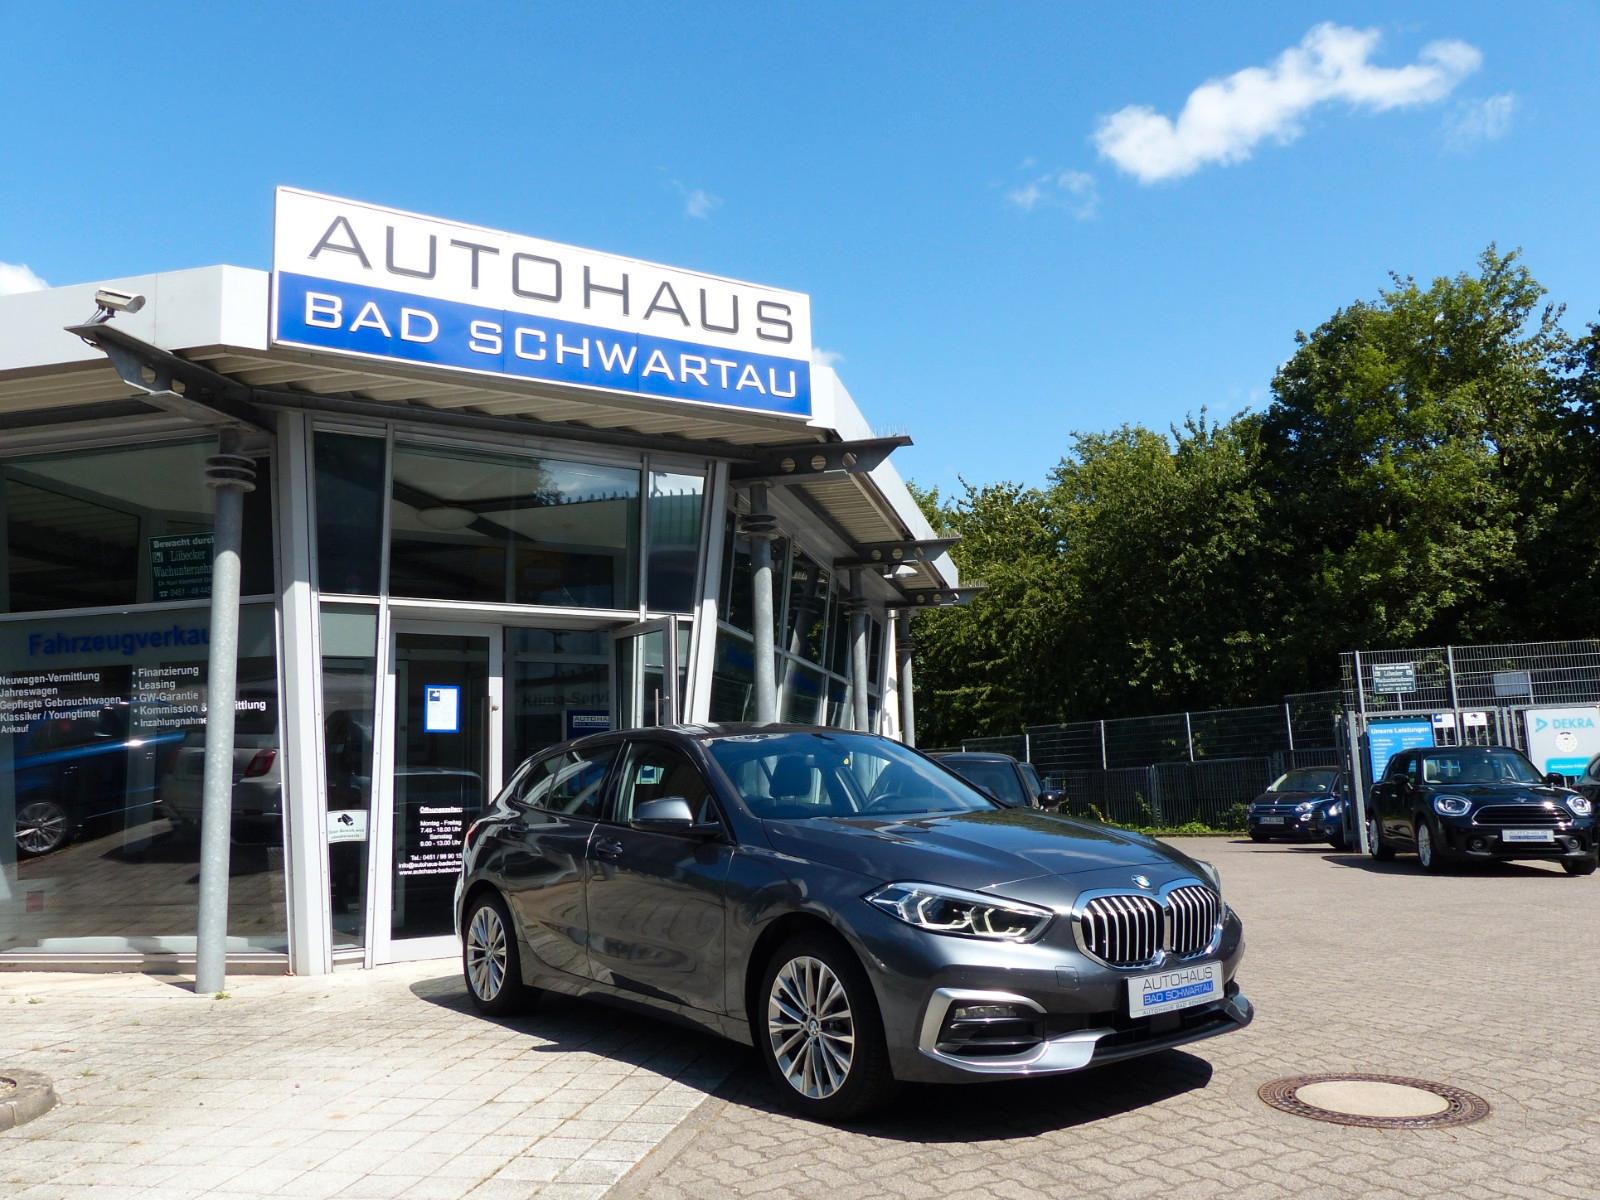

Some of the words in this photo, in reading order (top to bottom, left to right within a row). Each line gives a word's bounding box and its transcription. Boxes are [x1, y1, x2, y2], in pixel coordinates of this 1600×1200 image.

[307, 215, 793, 344] AUTOHAUS
[304, 290, 440, 344] BAD
[467, 319, 797, 400] SCHWARTAU
[28, 624, 211, 656] Fahrzeugverkau
[138, 666, 199, 678] Finanzierung
[0, 672, 100, 686] Neuwagen-Vermittlung
[138, 680, 176, 691] Leasing
[0, 687, 58, 698] Jahreswagen
[139, 691, 199, 702] GW-Garantie
[0, 700, 43, 711] Gepflegte
[44, 696, 122, 708] Gebrauchtwagen
[140, 703, 198, 715] Kommission
[235, 700, 266, 711] ittlung
[0, 713, 41, 722] Klassiker
[48, 709, 101, 721] Youngtimer
[1, 724, 29, 734] Ankauf
[140, 717, 208, 728] Inzahlungnahme
[1552, 718, 1594, 729] DEKRA
[1143, 967, 1213, 992] AUTOHAUS
[1144, 994, 1164, 1005] BAD
[1165, 982, 1213, 1001] SCHWARTAU
